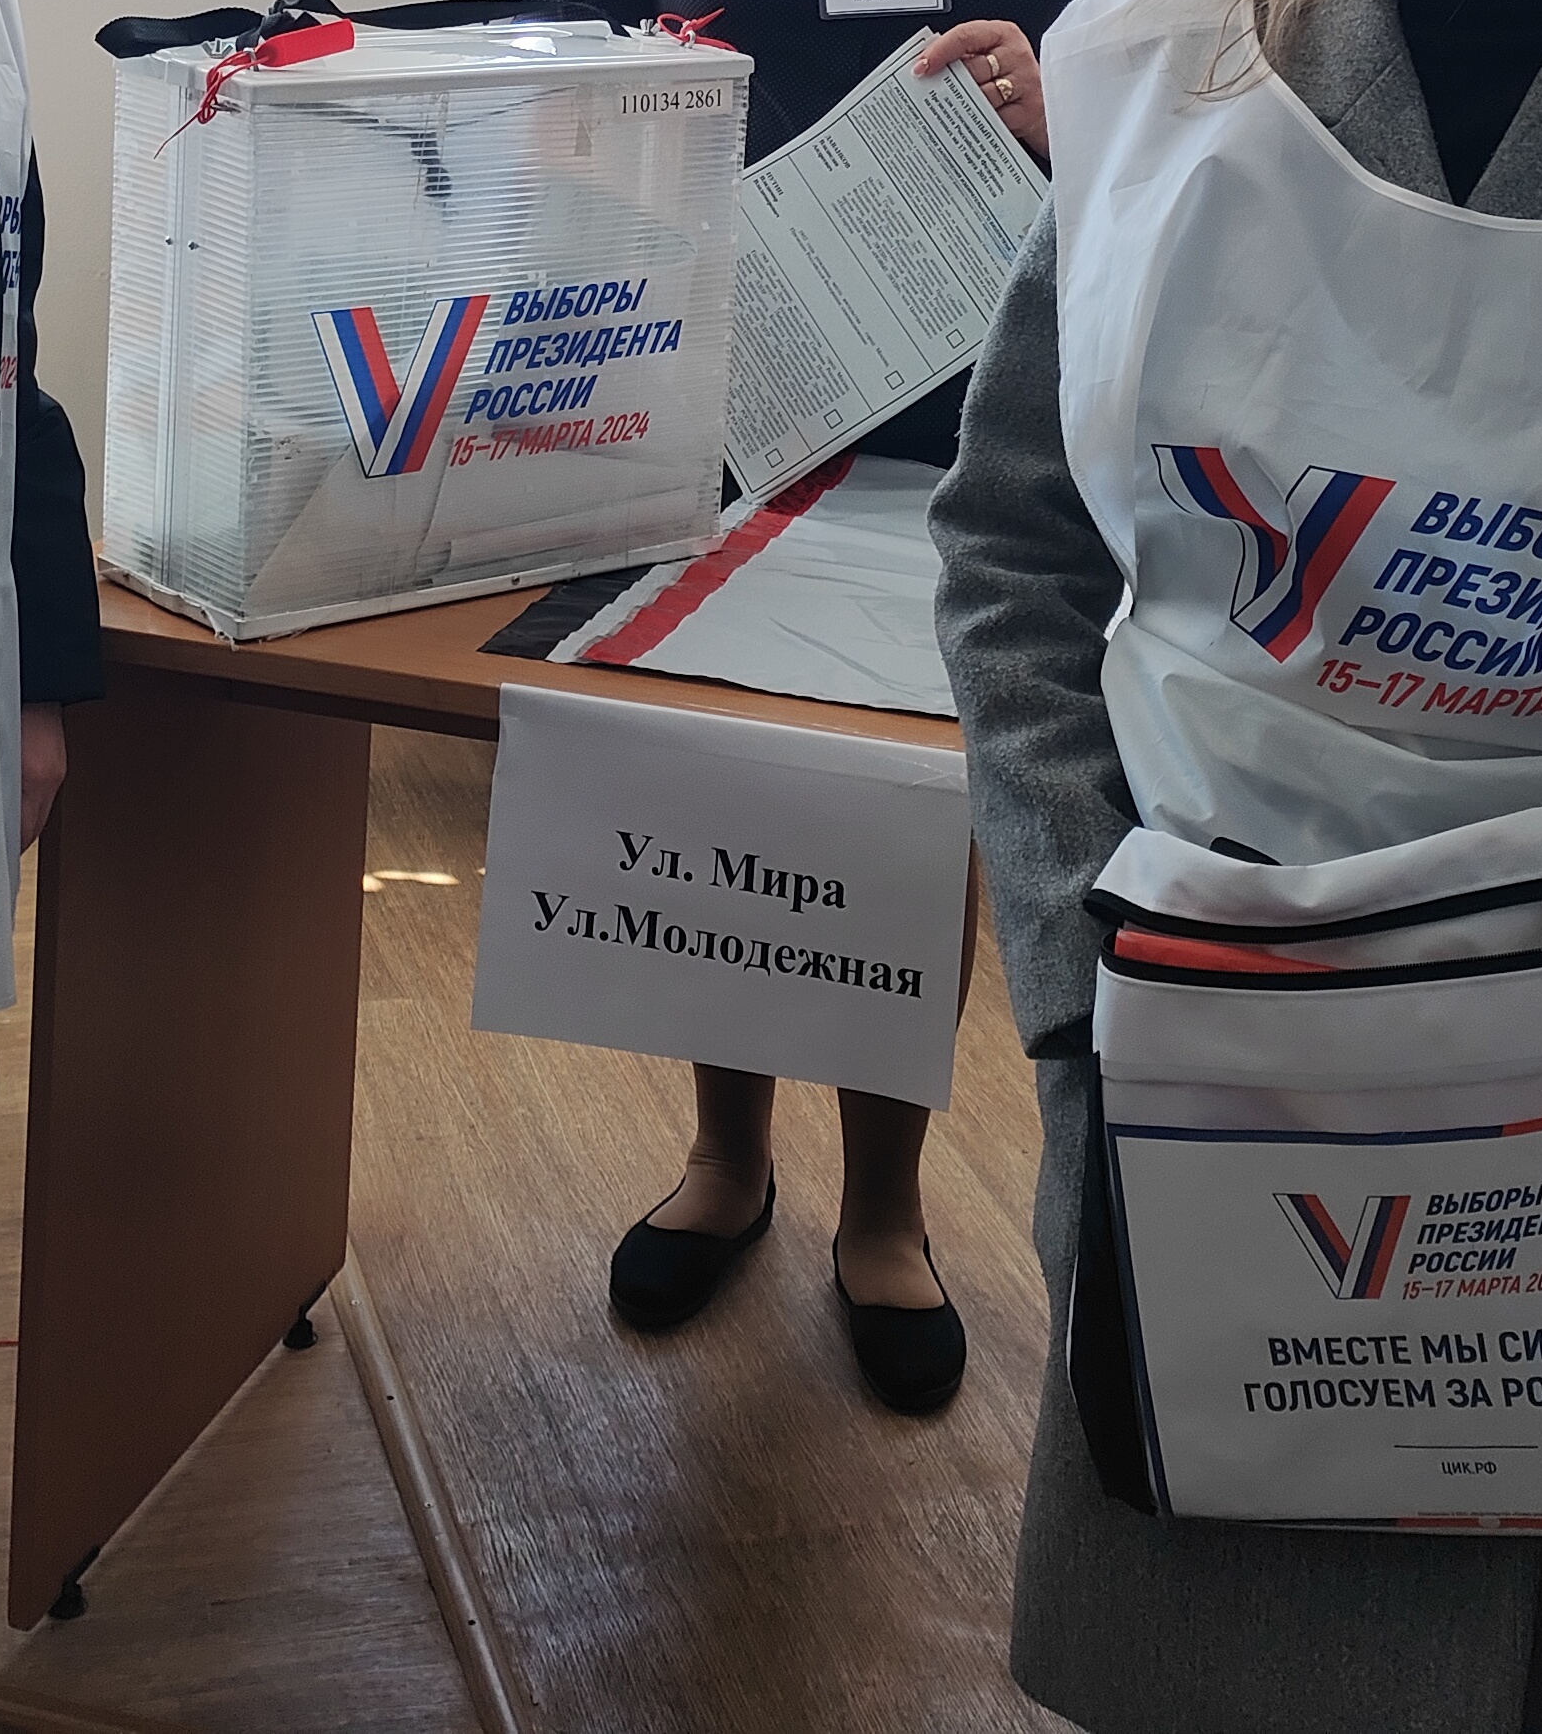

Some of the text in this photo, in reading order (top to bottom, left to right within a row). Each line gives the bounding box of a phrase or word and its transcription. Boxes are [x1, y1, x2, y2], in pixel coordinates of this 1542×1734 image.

[621, 88, 723, 115] 110134 2861
[503, 278, 647, 326] ВЫБОРЫ
[484, 319, 683, 374] ПРЕЗИДЕНТА
[464, 375, 599, 424] РОССИИ
[517, 420, 592, 458] МАРТА
[596, 411, 651, 446] 2024
[615, 829, 847, 914] Ул. Мира
[530, 889, 924, 1001] Ул.Молодежная
[1407, 1248, 1515, 1275] РОССИИ
[1456, 1275, 1522, 1298] МАРТА
[1267, 1333, 1410, 1367] ВМЕСТЕ
[1421, 1332, 1489, 1364] МЫ
[1243, 1377, 1435, 1413] ГОЛОСУЕМ
[1446, 1376, 1493, 1409] ЗА
[1441, 1459, 1497, 1477] ЦИК.РФ
